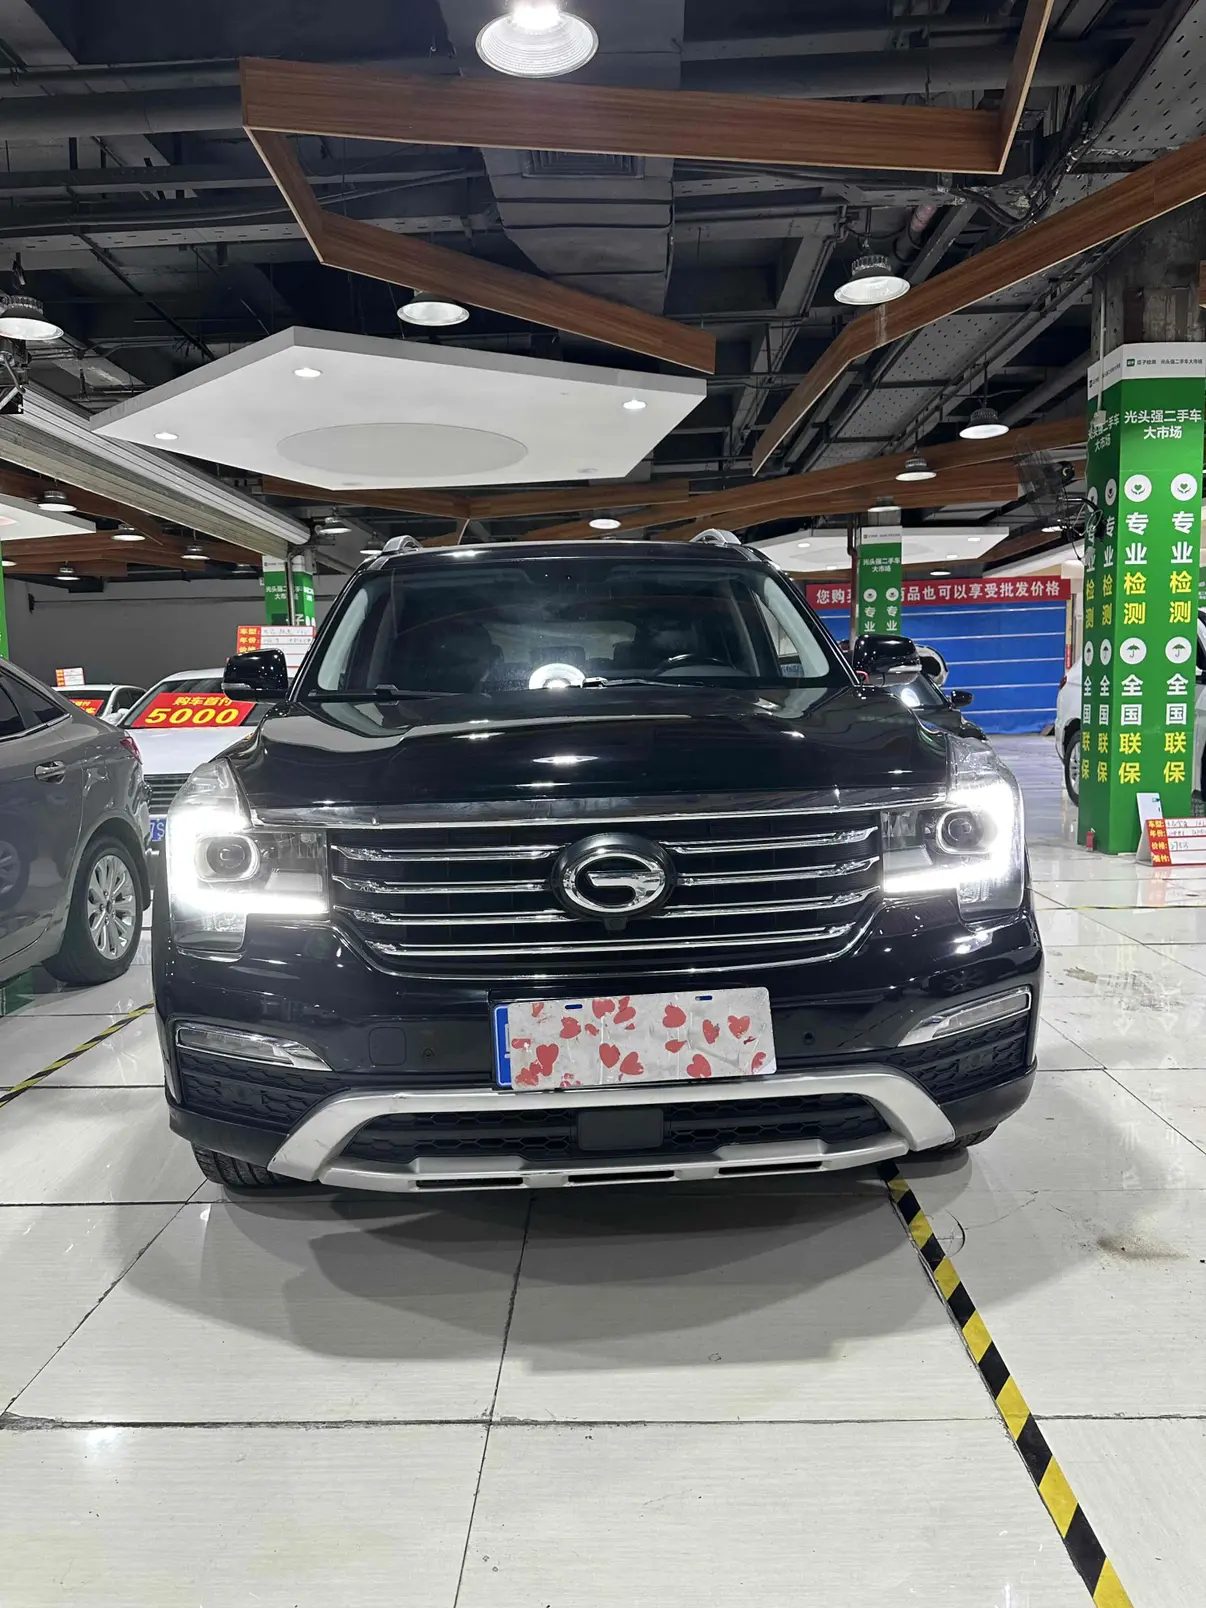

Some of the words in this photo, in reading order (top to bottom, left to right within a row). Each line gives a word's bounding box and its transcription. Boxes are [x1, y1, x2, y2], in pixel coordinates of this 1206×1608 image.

[1094, 433, 1111, 453] 大市场
[1124, 408, 1202, 423] 光头强二手车
[1143, 426, 1183, 440] 大市场
[1101, 515, 1116, 626] 专业检测
[1123, 511, 1149, 625] 专业检测
[1169, 510, 1195, 624] 专业检测
[144, 708, 240, 724] 5000
[173, 696, 233, 706] 购车首付
[1081, 675, 1092, 781] 全国联保
[1096, 674, 1111, 783] 全国联保
[1118, 673, 1144, 785] 全国联保
[1163, 672, 1189, 784] 全国联保
